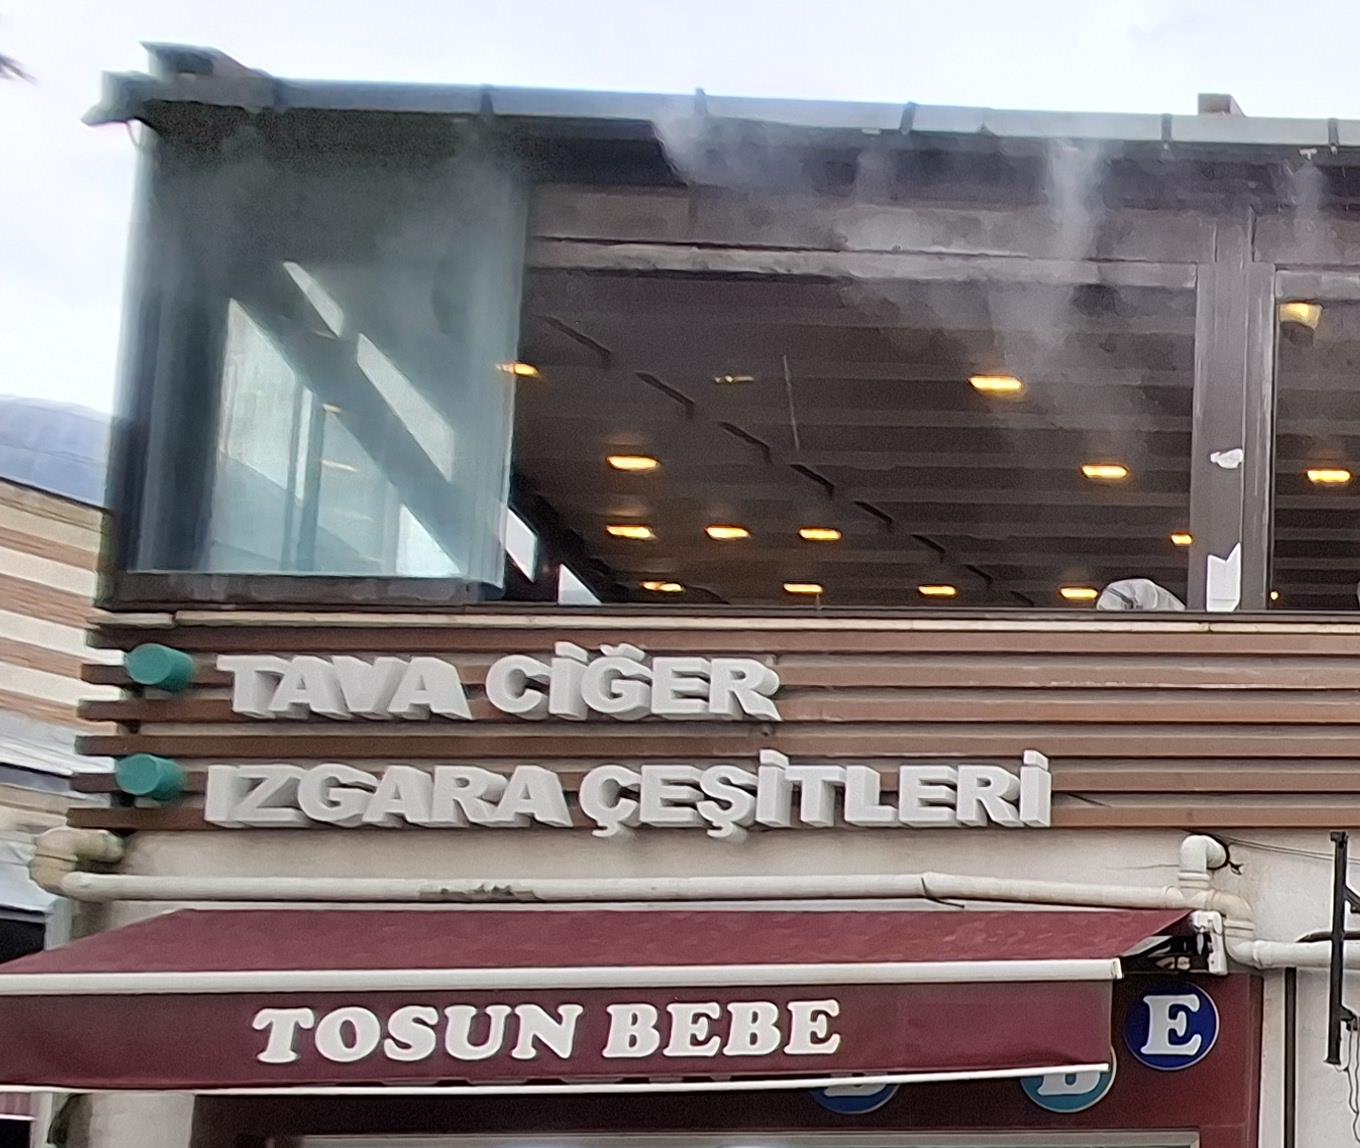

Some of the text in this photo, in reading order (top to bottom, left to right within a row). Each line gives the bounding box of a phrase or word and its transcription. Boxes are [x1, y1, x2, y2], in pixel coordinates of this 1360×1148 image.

[216, 641, 783, 722] TAVA CİĞER
[204, 749, 1052, 838] IZGARA ÇEŞİTLERİ
[252, 998, 842, 1066] TOSUN BEBE
